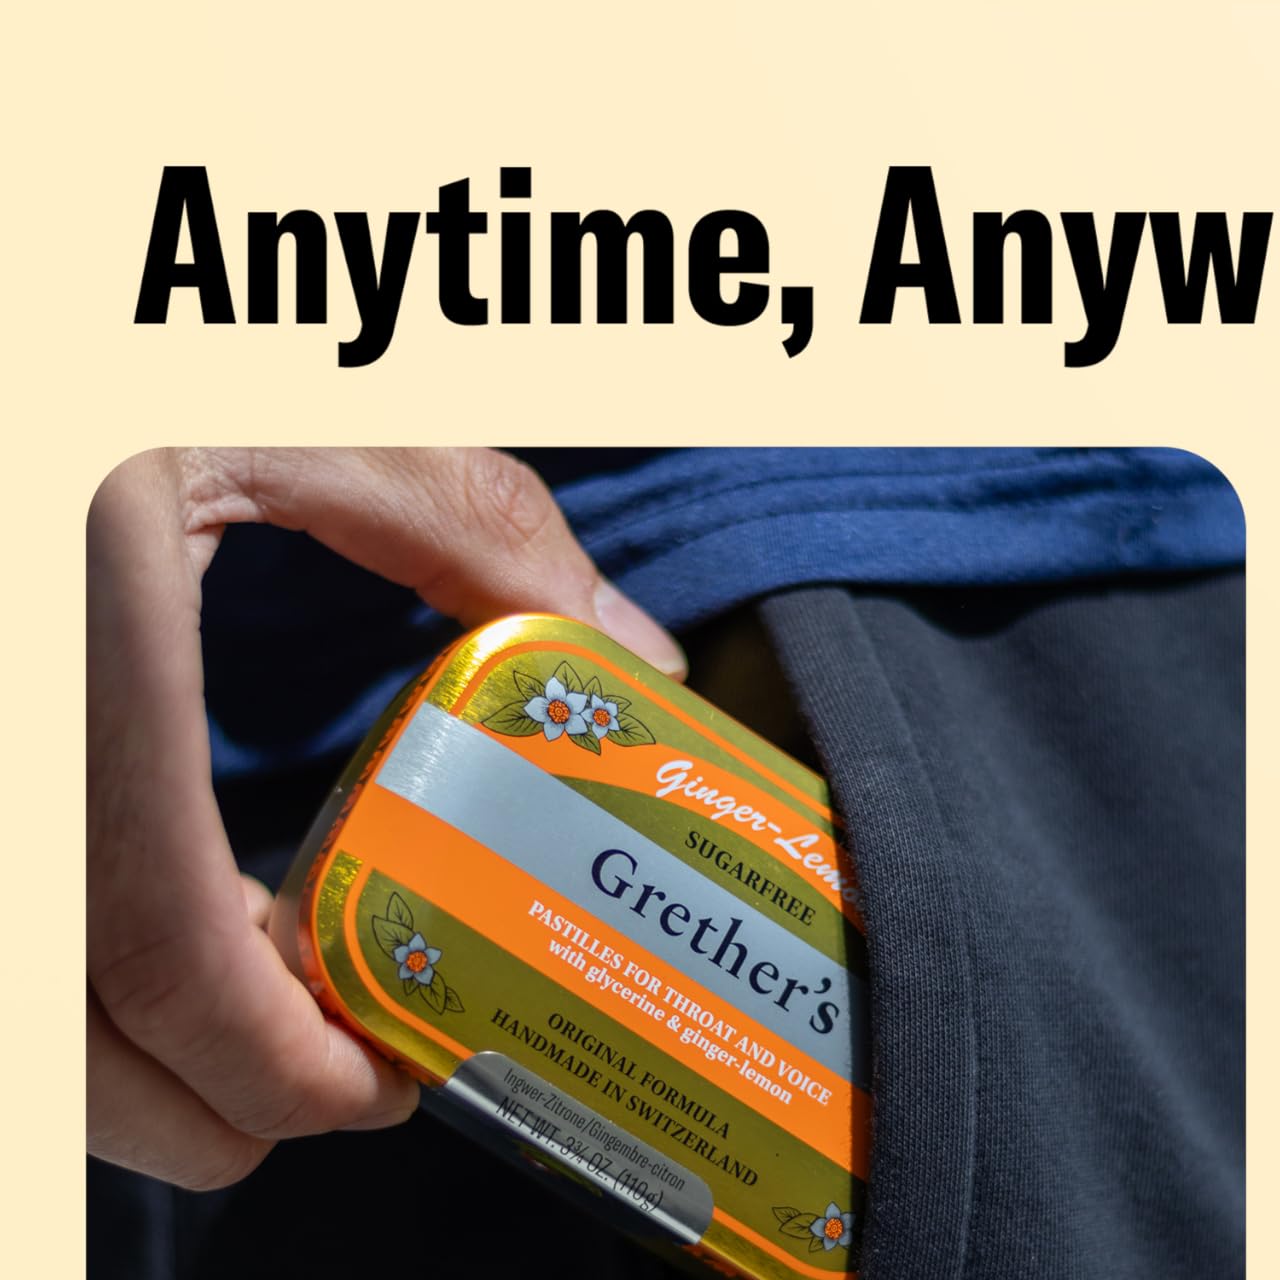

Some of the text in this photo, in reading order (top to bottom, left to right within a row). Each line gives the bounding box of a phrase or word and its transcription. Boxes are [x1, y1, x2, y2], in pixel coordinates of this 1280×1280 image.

[656, 760, 864, 910] Ginger-Lemo
[685, 830, 816, 926] SUGARFREE
[528, 900, 832, 1106] PASTILLES FOR THROAT AND VOICE
[548, 1012, 729, 1139] ORIGINAL FORMULA
[549, 940, 793, 1105] with glycerine & ginger-lemon
[491, 1009, 758, 1187] HANDMADE IN SWITZERLAND
[496, 1096, 532, 1127] NET
[530, 1118, 561, 1148] WT.
[587, 1152, 613, 1181] OZ.
[613, 1168, 664, 1212] (110g)
